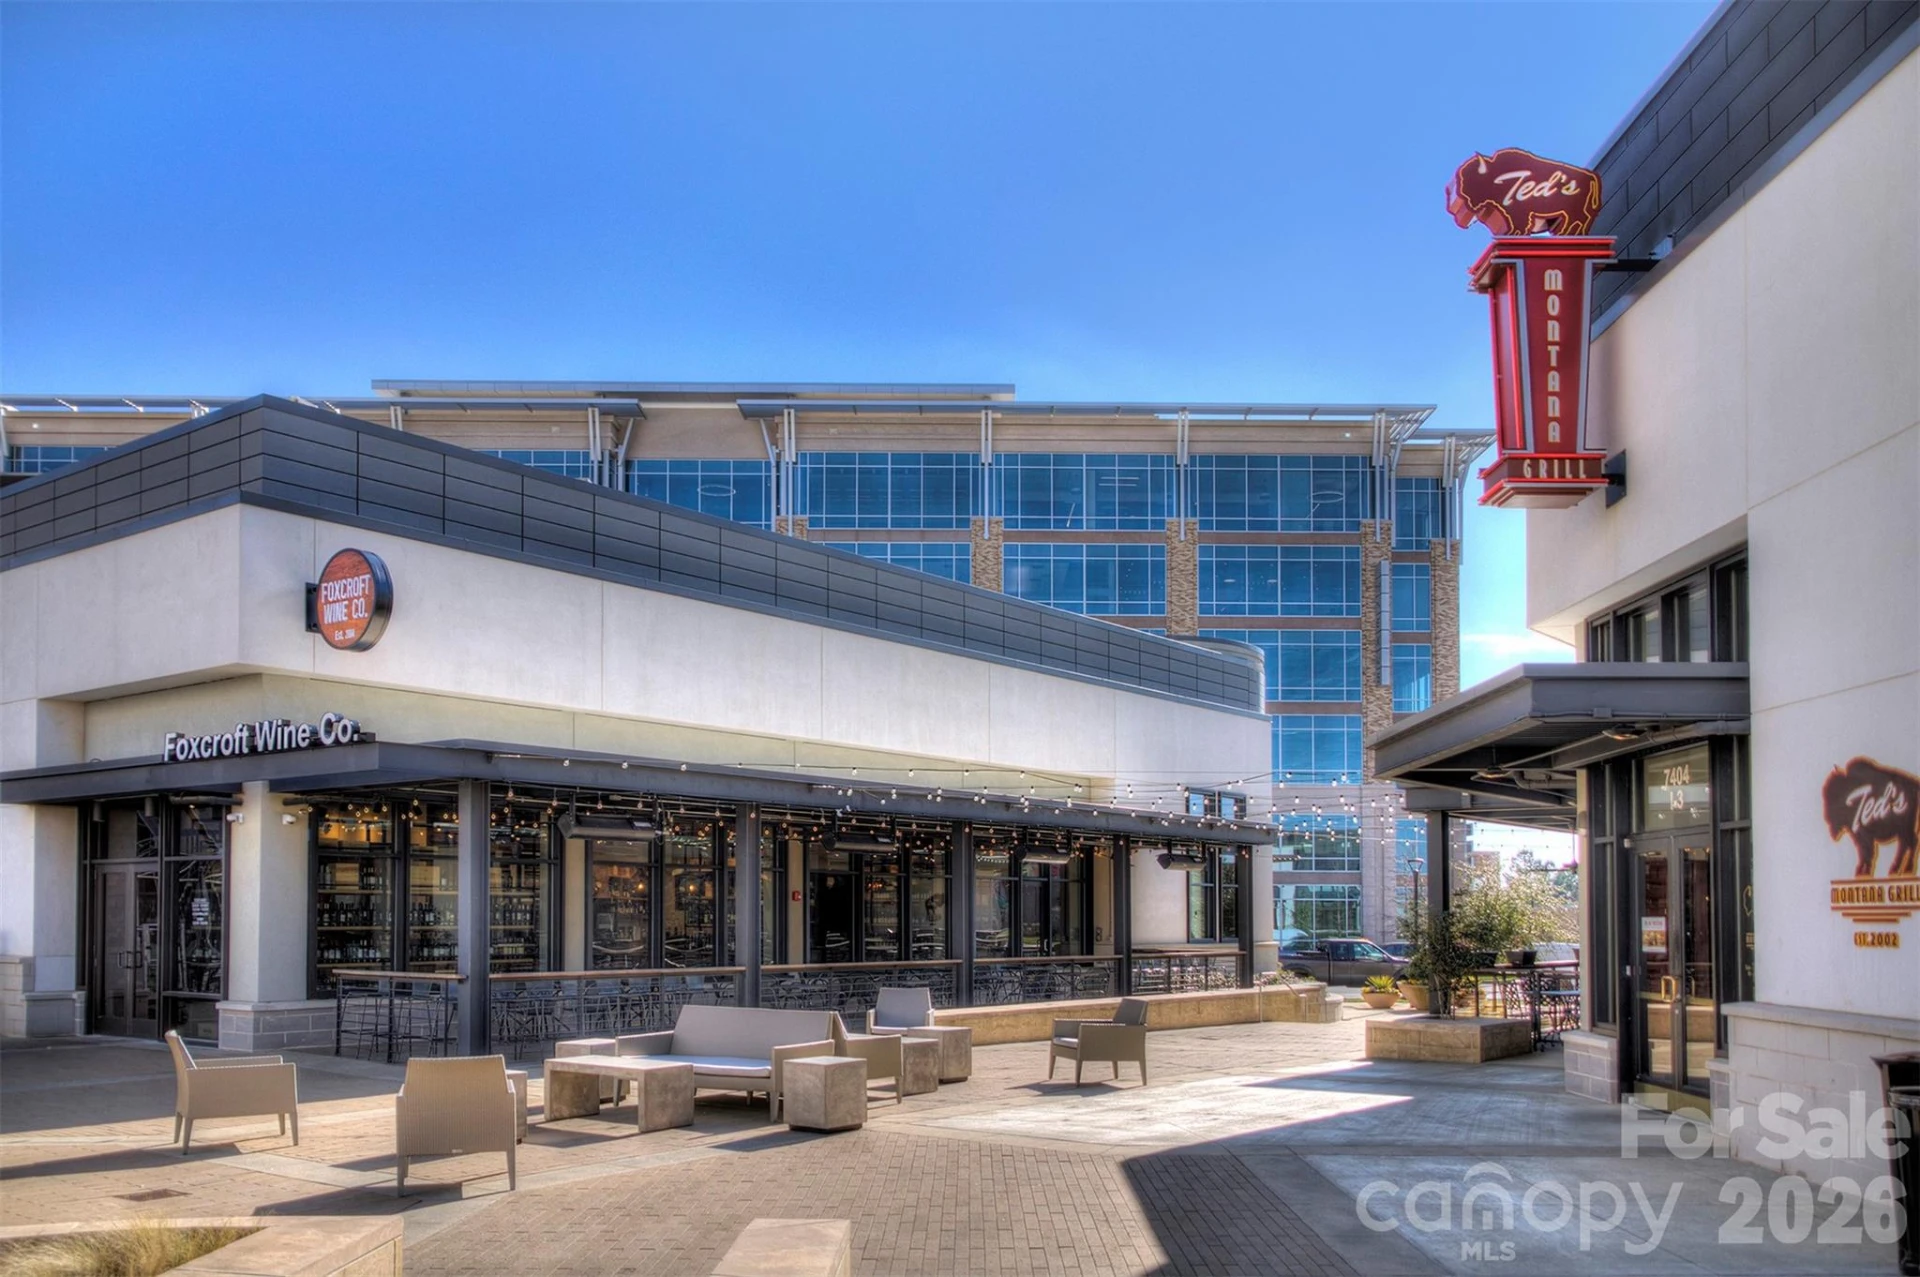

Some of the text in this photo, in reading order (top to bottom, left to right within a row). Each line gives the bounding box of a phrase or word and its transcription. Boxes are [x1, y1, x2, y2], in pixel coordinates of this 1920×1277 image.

[1494, 169, 1580, 206] Ted's
[1544, 269, 1563, 443] MONTANA
[1523, 458, 1586, 479] GRILL
[321, 574, 371, 604] FOXCROFT
[323, 598, 368, 625] WINE CO.
[164, 712, 359, 762] Foxcroft Wine Co.
[1663, 764, 1690, 787] 7404
[1846, 781, 1908, 833] Ted's
[1831, 885, 1885, 904] MONTANA
